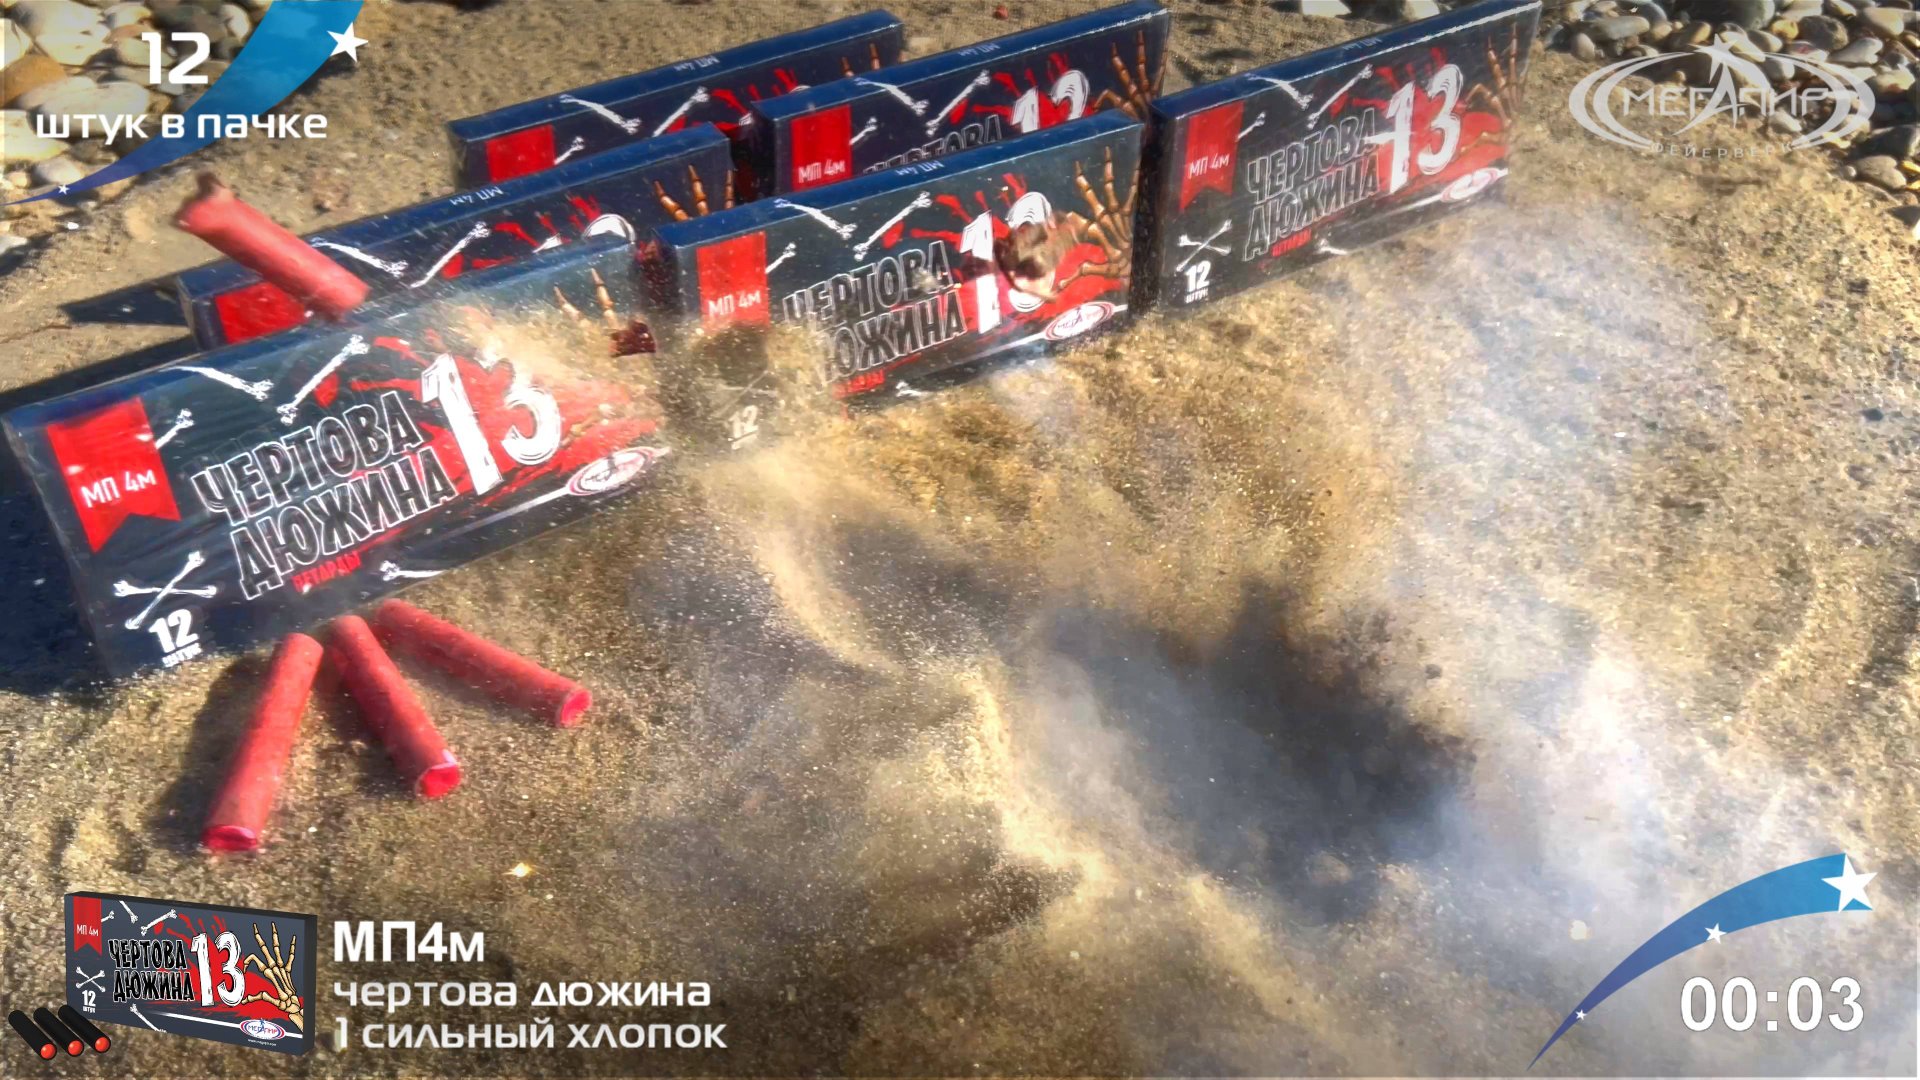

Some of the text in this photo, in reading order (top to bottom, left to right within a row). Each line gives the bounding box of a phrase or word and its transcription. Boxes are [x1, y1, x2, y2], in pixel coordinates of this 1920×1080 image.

[1247, 108, 1378, 204] ЧЕРТОВА
[1386, 63, 1464, 194] 13
[798, 162, 822, 184] МП
[1188, 156, 1209, 179] МП
[1242, 150, 1380, 262] ДЮЖИНА
[708, 297, 735, 317] МП
[783, 240, 961, 329] ЧЕРТОВА
[1185, 260, 1211, 292] 12
[813, 289, 968, 385] ЮЖИНА
[728, 404, 759, 439] 12
[80, 476, 120, 508] МП
[190, 390, 425, 527] ЧЕРТОВА
[230, 446, 460, 601] ДЮЖИНА
[148, 608, 199, 654] 12
